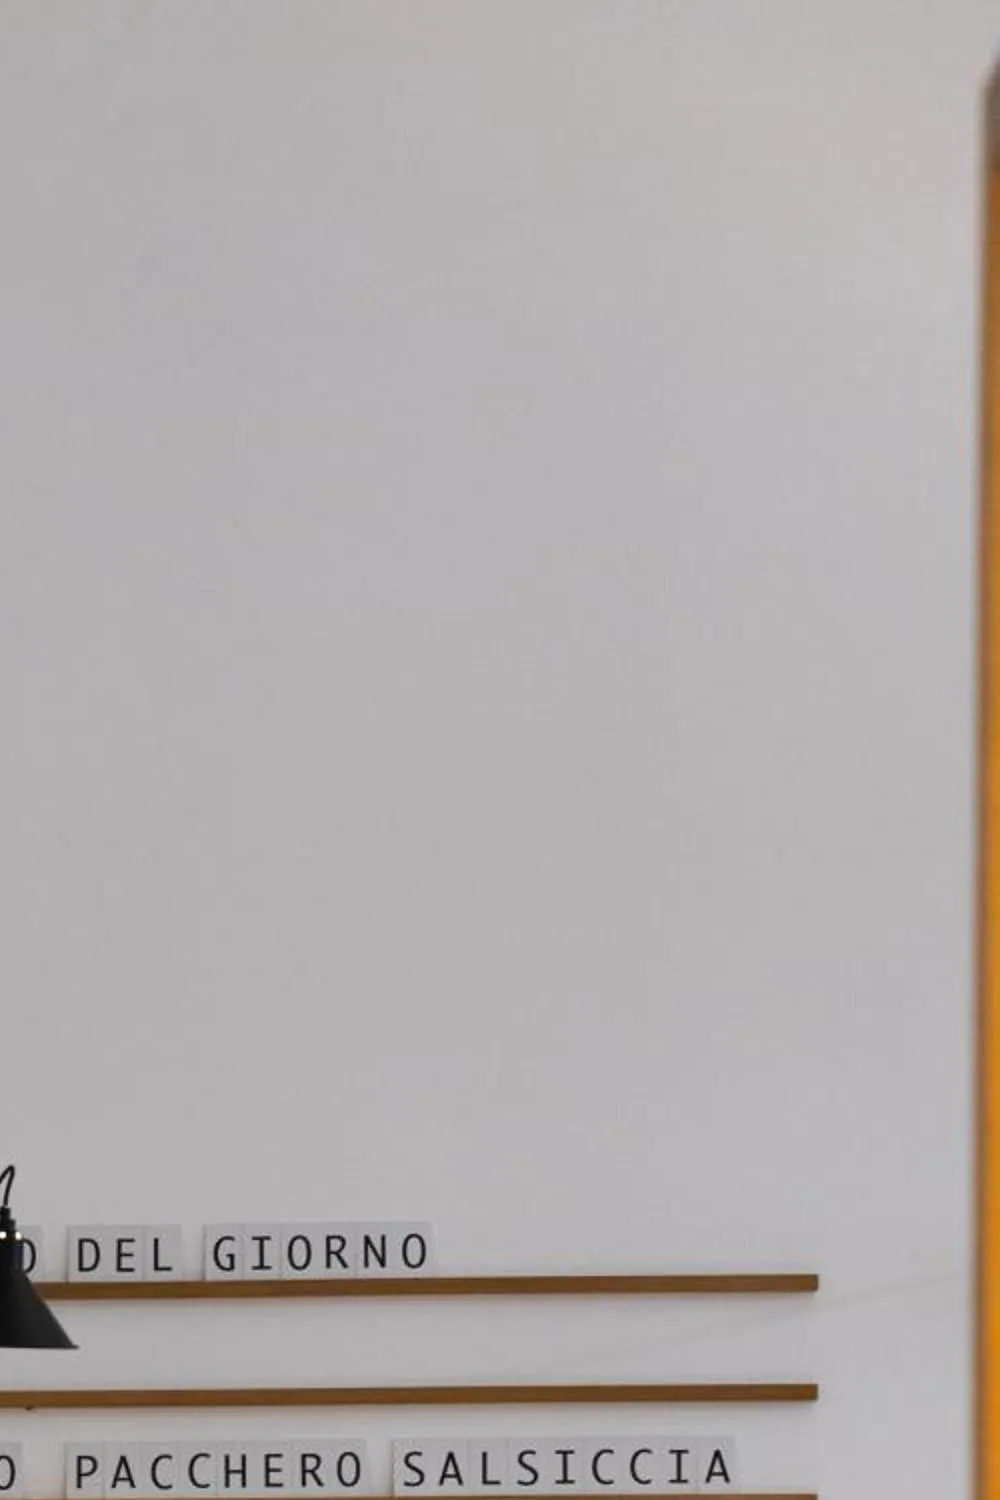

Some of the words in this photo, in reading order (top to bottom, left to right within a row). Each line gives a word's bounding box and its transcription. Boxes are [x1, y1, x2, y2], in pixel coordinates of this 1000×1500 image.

[77, 1237, 173, 1273] DEL
[213, 1233, 427, 1272] GIORNO
[75, 1451, 361, 1491] PACCHERO
[403, 1448, 731, 1488] SALSICCIA
